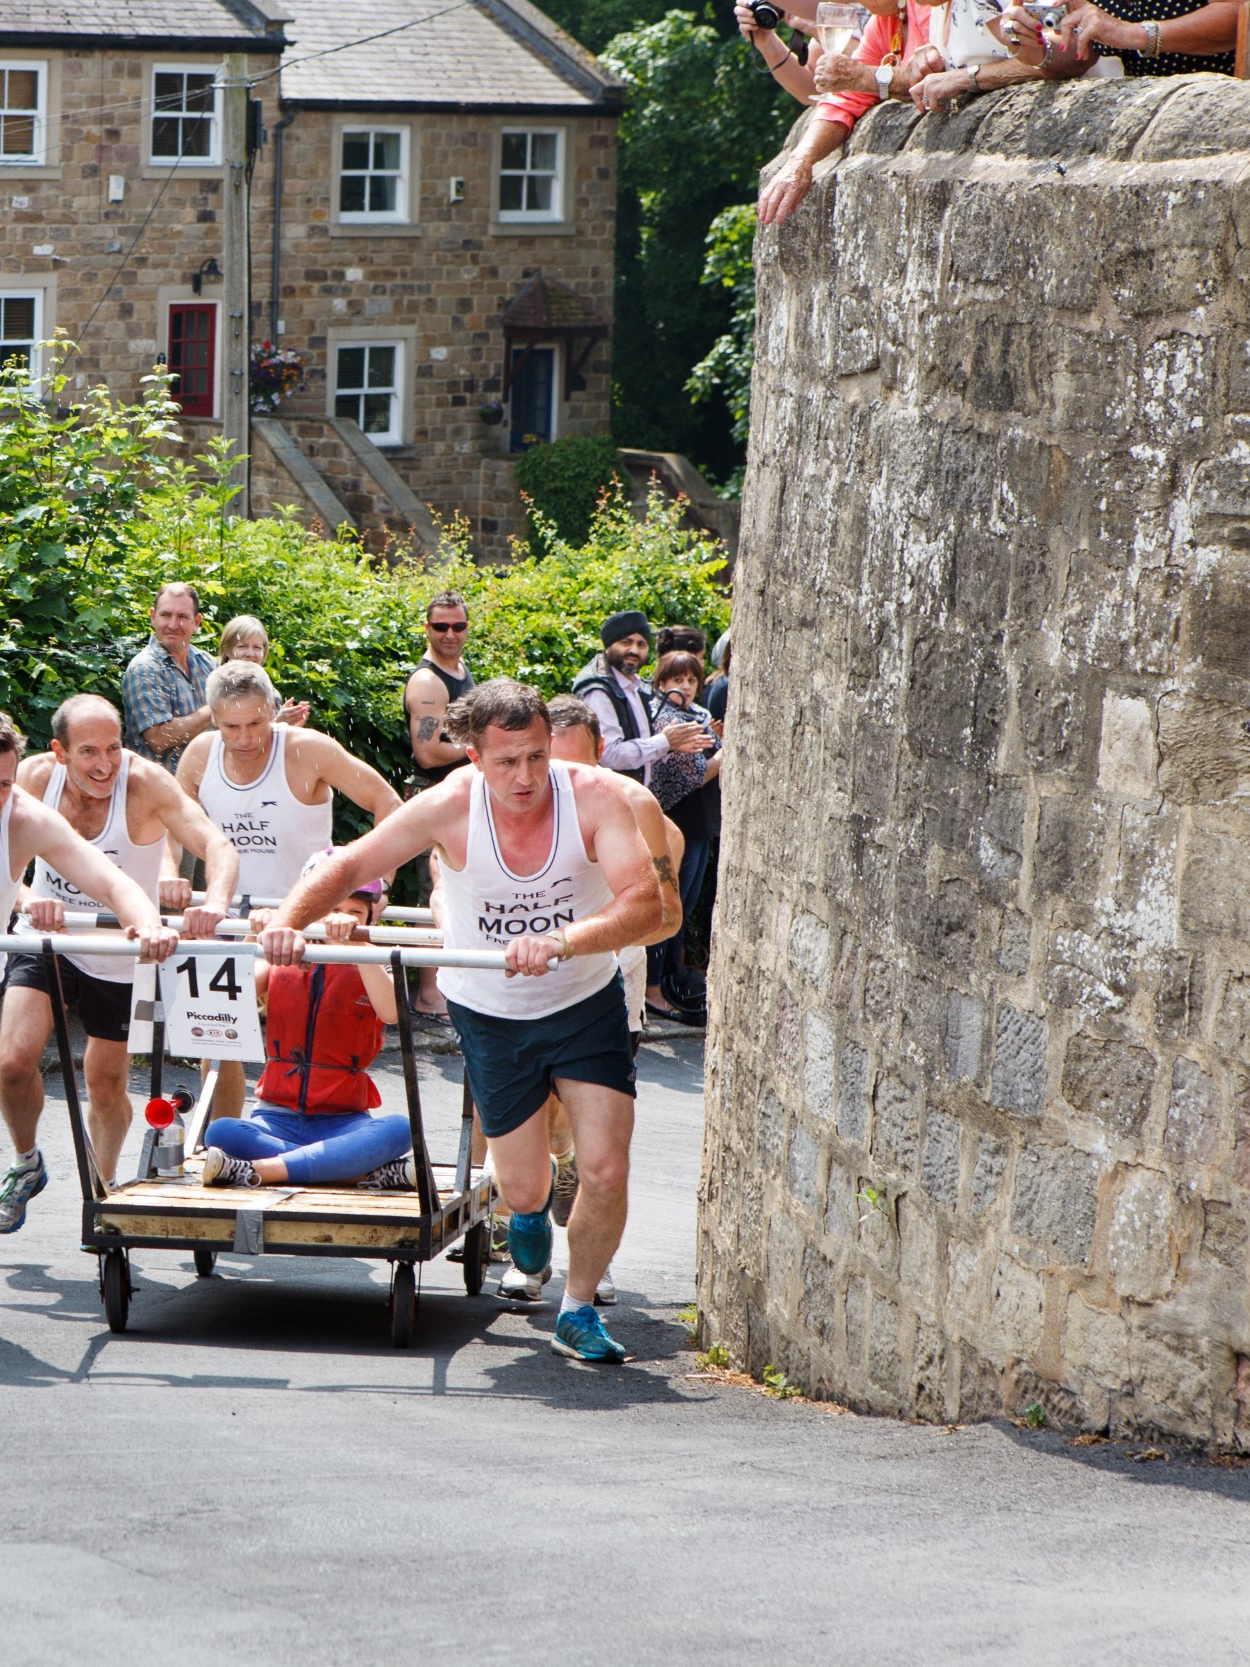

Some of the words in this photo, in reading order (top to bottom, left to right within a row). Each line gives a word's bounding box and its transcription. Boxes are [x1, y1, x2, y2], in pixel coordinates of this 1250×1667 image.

[221, 821, 270, 833] HALF
[46, 871, 81, 895] MO
[484, 894, 573, 915] HALF
[511, 890, 546, 900] THE
[478, 908, 575, 935] MOON
[176, 956, 243, 1001] 14
[186, 1011, 238, 1025] Piccadilly
